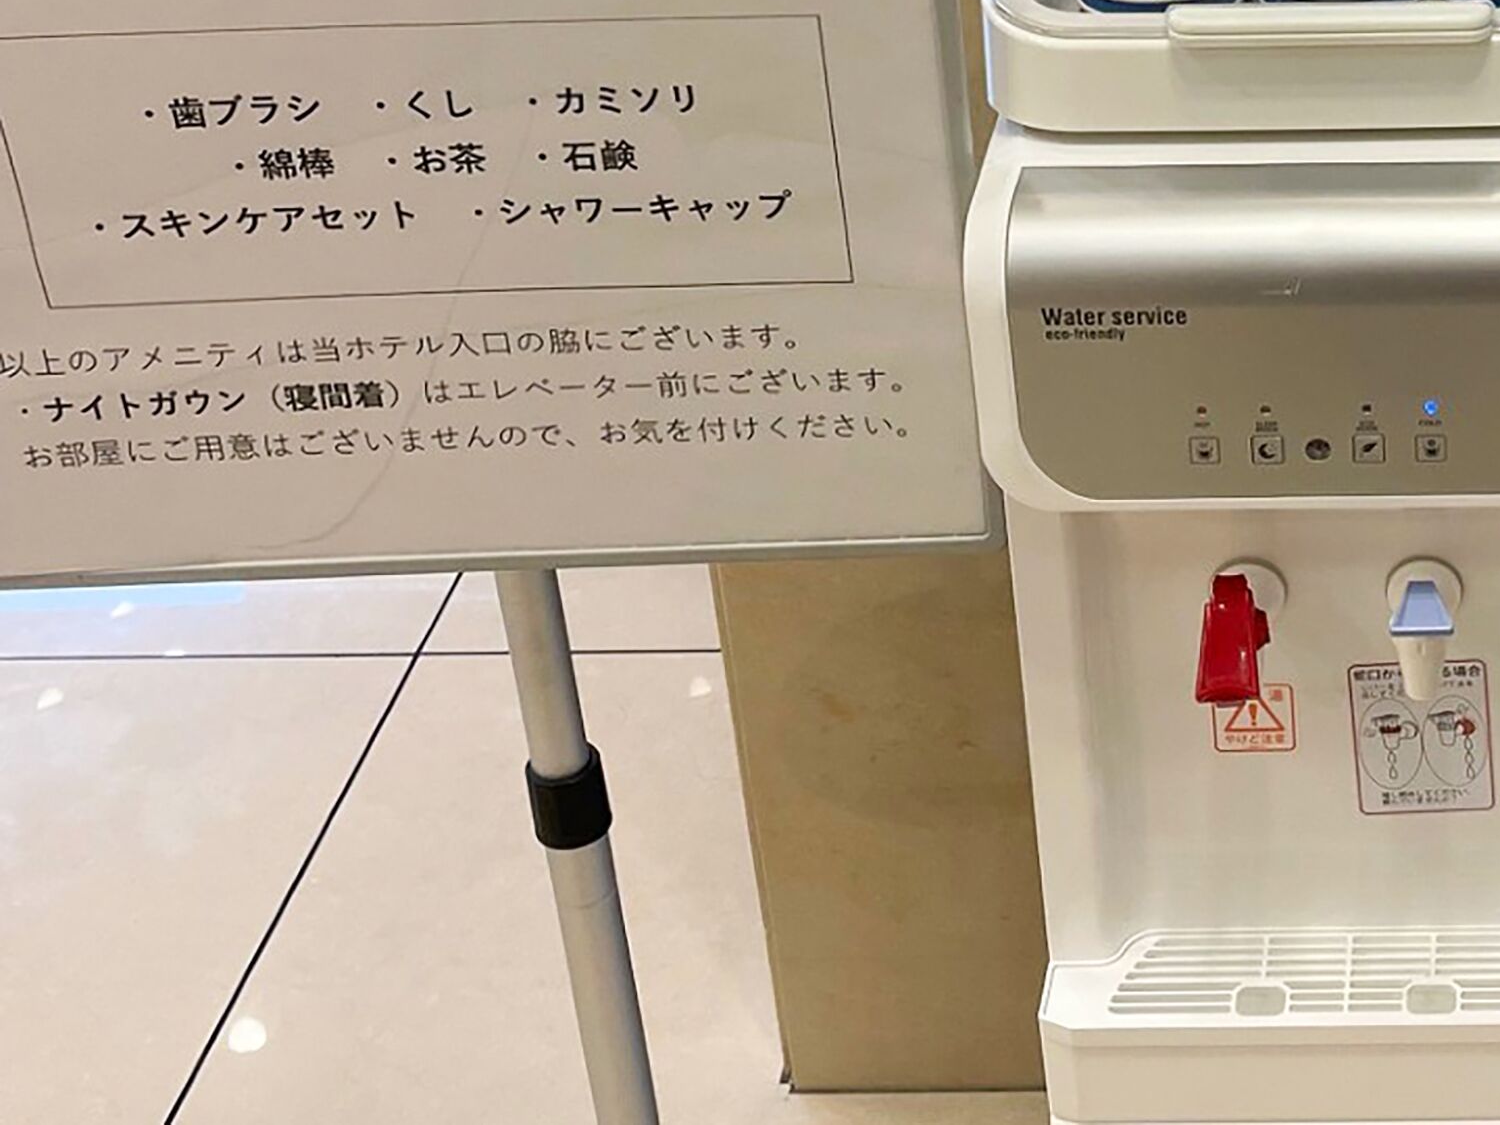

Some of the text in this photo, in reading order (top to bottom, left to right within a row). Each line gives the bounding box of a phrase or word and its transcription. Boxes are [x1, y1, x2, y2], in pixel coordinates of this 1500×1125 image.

[1041, 308, 1188, 326] Water service
[1045, 327, 1126, 341] eco-friendly
